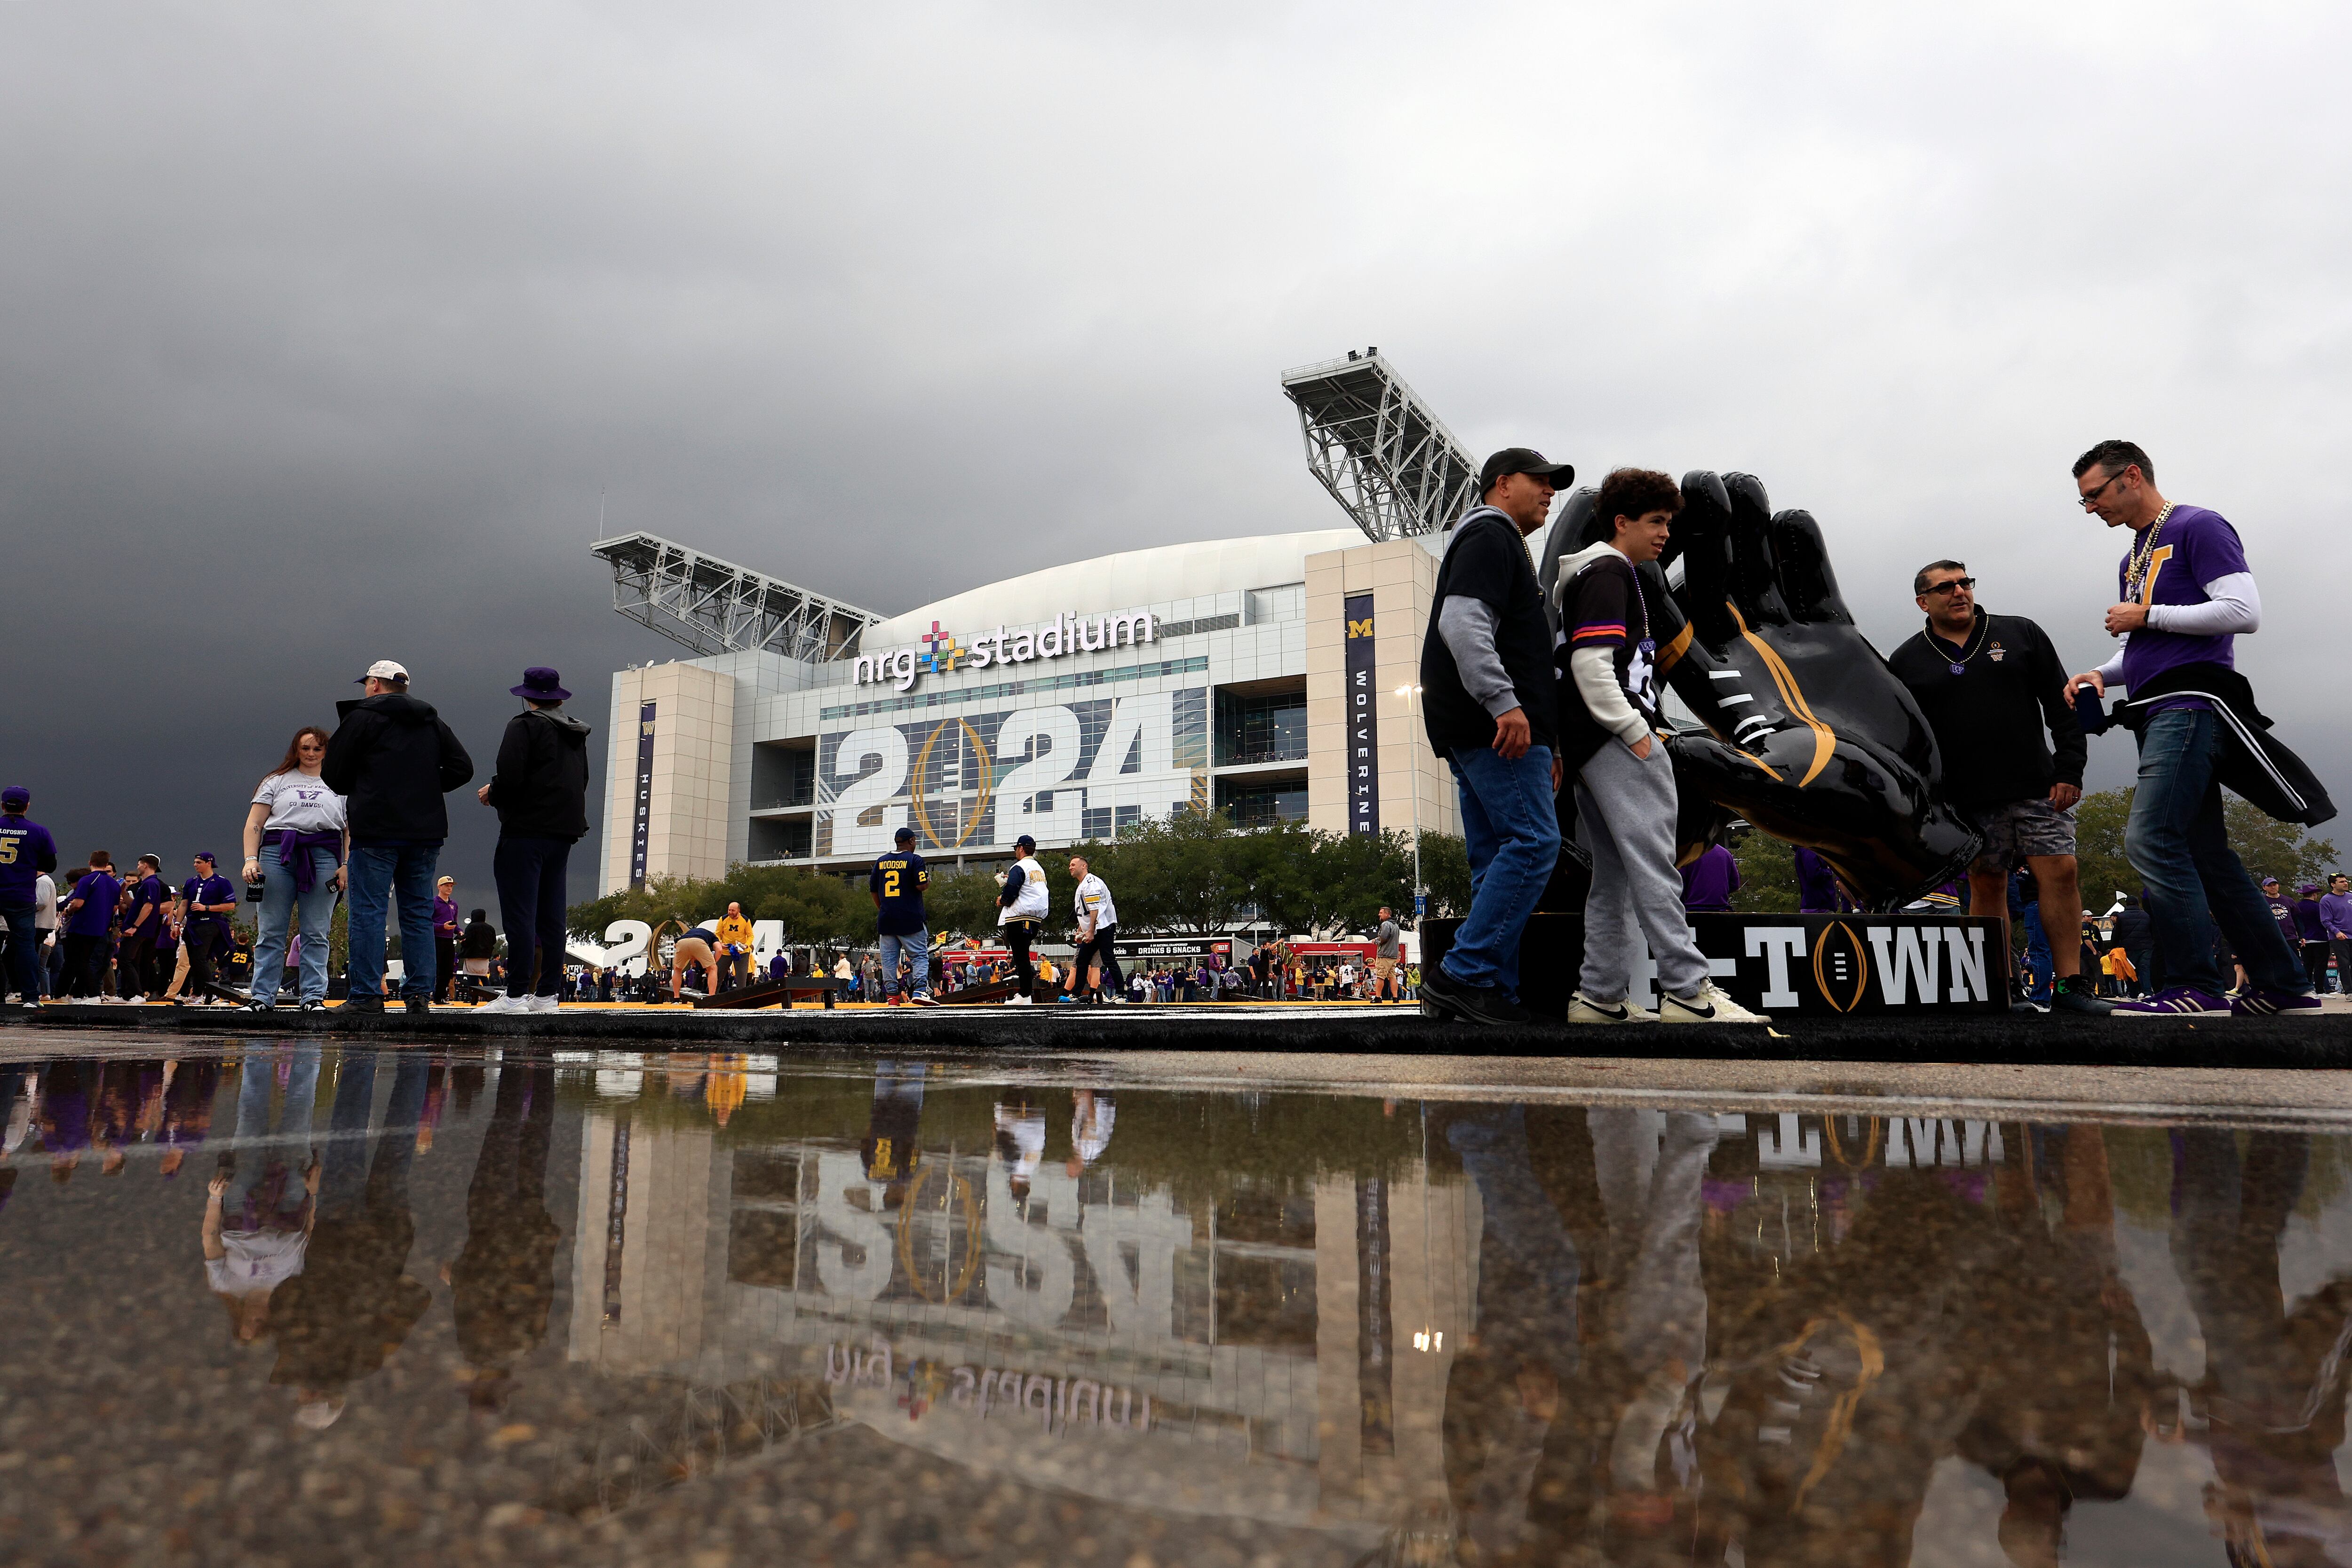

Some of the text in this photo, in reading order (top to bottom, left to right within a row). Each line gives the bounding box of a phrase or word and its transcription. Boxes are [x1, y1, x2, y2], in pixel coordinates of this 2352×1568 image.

[1349, 619, 1373, 638] M
[852, 610, 1154, 691] nrg stadium
[642, 720, 655, 735] W
[636, 774, 649, 878] HUSKIES
[879, 860, 907, 870] WOODSON
[885, 870, 900, 897] 2
[918, 871, 927, 882] 2
[232, 952, 247, 963] 25
[566, 964, 584, 973] NTRY
